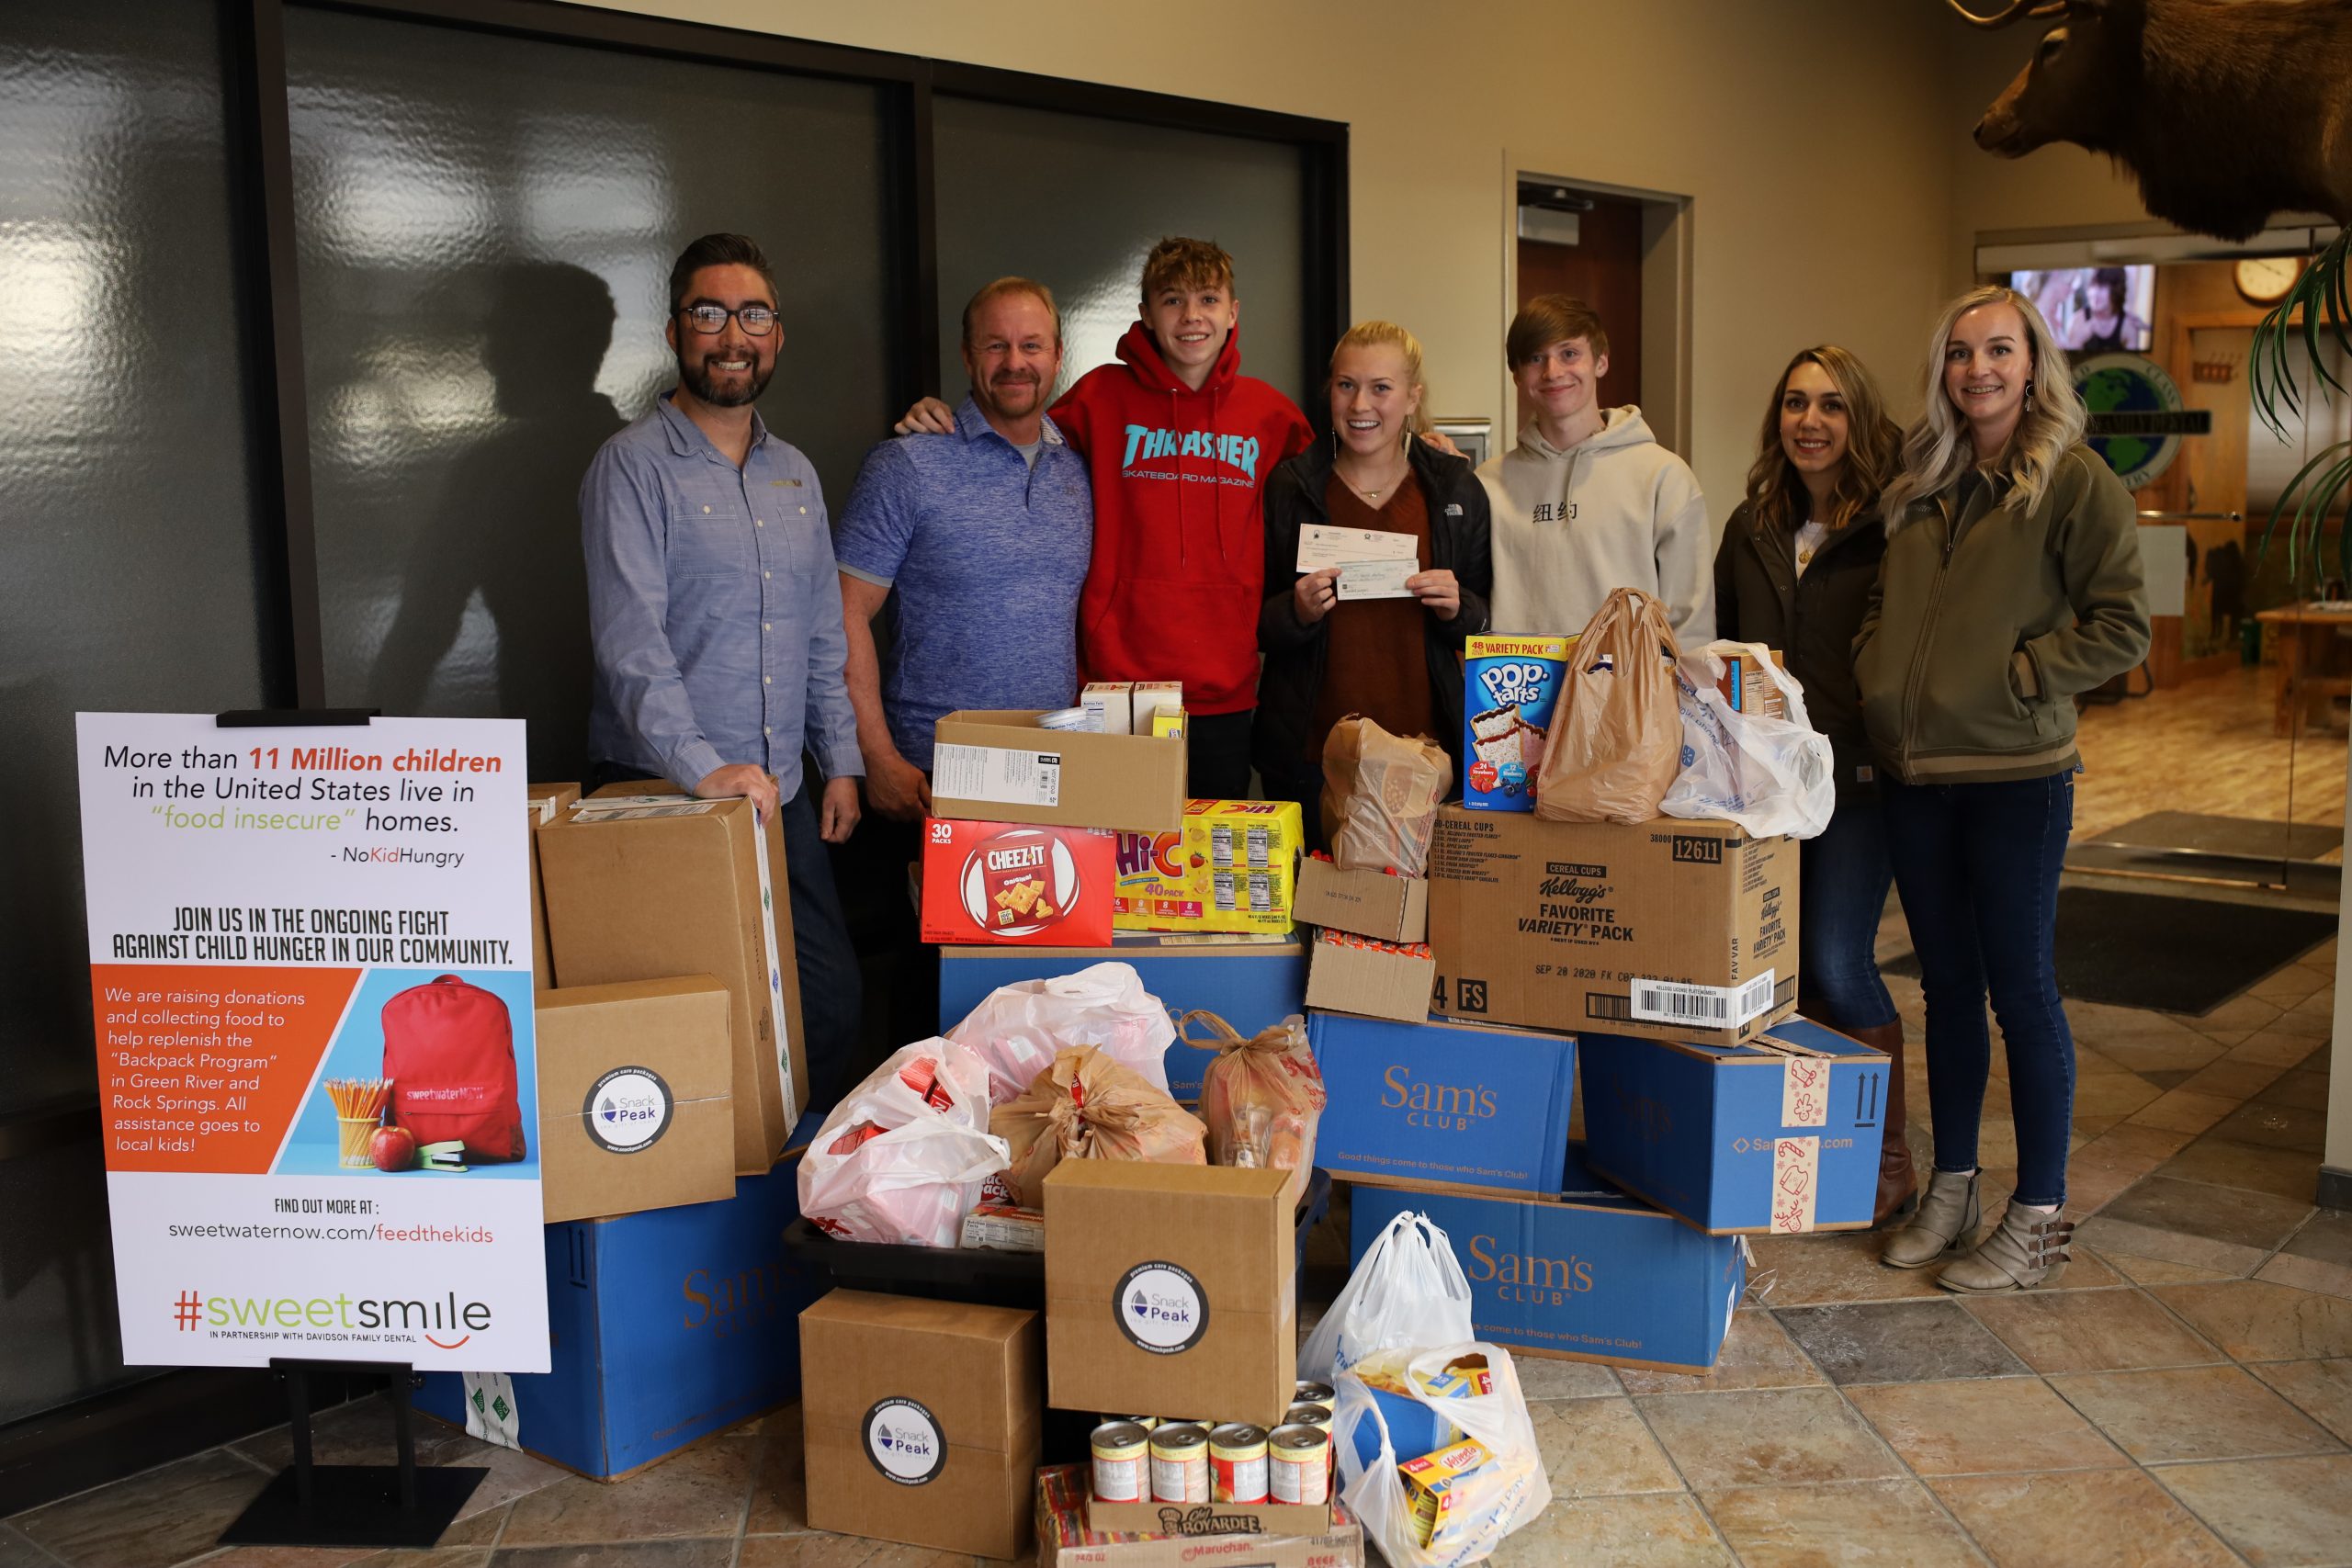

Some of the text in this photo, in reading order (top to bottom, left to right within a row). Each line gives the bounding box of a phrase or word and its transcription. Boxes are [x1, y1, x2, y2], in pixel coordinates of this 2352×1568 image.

[1122, 423, 1260, 482] THRASHER
[1122, 468, 1256, 489] SKATEBOARD MAGAZINE
[1532, 501, 1577, 524] 纽约
[1486, 643, 1520, 654] VARIETY
[1521, 644, 1544, 655] PACK
[104, 745, 502, 773] More than 11 Million children
[132, 774, 474, 803] in the United States live in
[366, 807, 458, 832] homes.
[1474, 822, 1494, 832] CUPS
[931, 823, 952, 839] 30
[343, 846, 465, 869] NoKidHungry
[1114, 829, 1185, 879] Hi-C
[1650, 833, 1721, 862] 38000 12611
[1549, 864, 1602, 876] CEREAL CUPS
[1145, 883, 1184, 897] 40 PACK
[173, 907, 449, 936] JOIN US IN THE ONGOING FIGHT
[1539, 903, 1615, 924] FAVORITE
[1589, 924, 1634, 942] PACK
[1759, 918, 1781, 938] FAVORITE
[1773, 928, 1786, 943] PACK
[112, 933, 513, 965] AGAINST CHILD HUNGER IN OUR COMMUNITY.
[1535, 964, 1555, 975] SEP
[1600, 970, 1612, 980] FK
[105, 987, 306, 1009] We are raising donations
[1433, 976, 1484, 1010] 4 FS
[106, 1009, 285, 1030] and collecting food to
[107, 1030, 253, 1050] help replenish the
[111, 1073, 260, 1090] in Green River and
[1381, 1065, 1498, 1118] Sam's
[113, 1094, 247, 1114] Rock Springs. All
[619, 1095, 655, 1109] Snack
[619, 1106, 656, 1122] Peak
[114, 1118, 261, 1135] assistance goes to
[116, 1135, 195, 1153] local kids!
[1338, 1151, 1529, 1179] Good things come to those who Sam's Club!
[274, 1198, 373, 1214] FIND OUT MORE AT
[168, 1223, 493, 1243] sweetwaternow.com/feedthekids
[1468, 1235, 1594, 1292] Sam's
[1151, 1293, 1190, 1308] Snack
[174, 1290, 492, 1332] #sweetsmile
[1151, 1306, 1190, 1323] Peak
[209, 1330, 417, 1343] IN PARTNERSHIP WITH DAVIDSON FAMILY DENTAL
[1483, 1324, 1643, 1349] come to those who Sam's Club!
[895, 1427, 929, 1442] Snack
[896, 1439, 930, 1456] Peak
[1444, 1446, 1477, 1469] Velveeta
[1409, 1462, 1419, 1472] 4
[1182, 1516, 1260, 1533] BOYARDEE
[1307, 1556, 1336, 1567] BEEF
